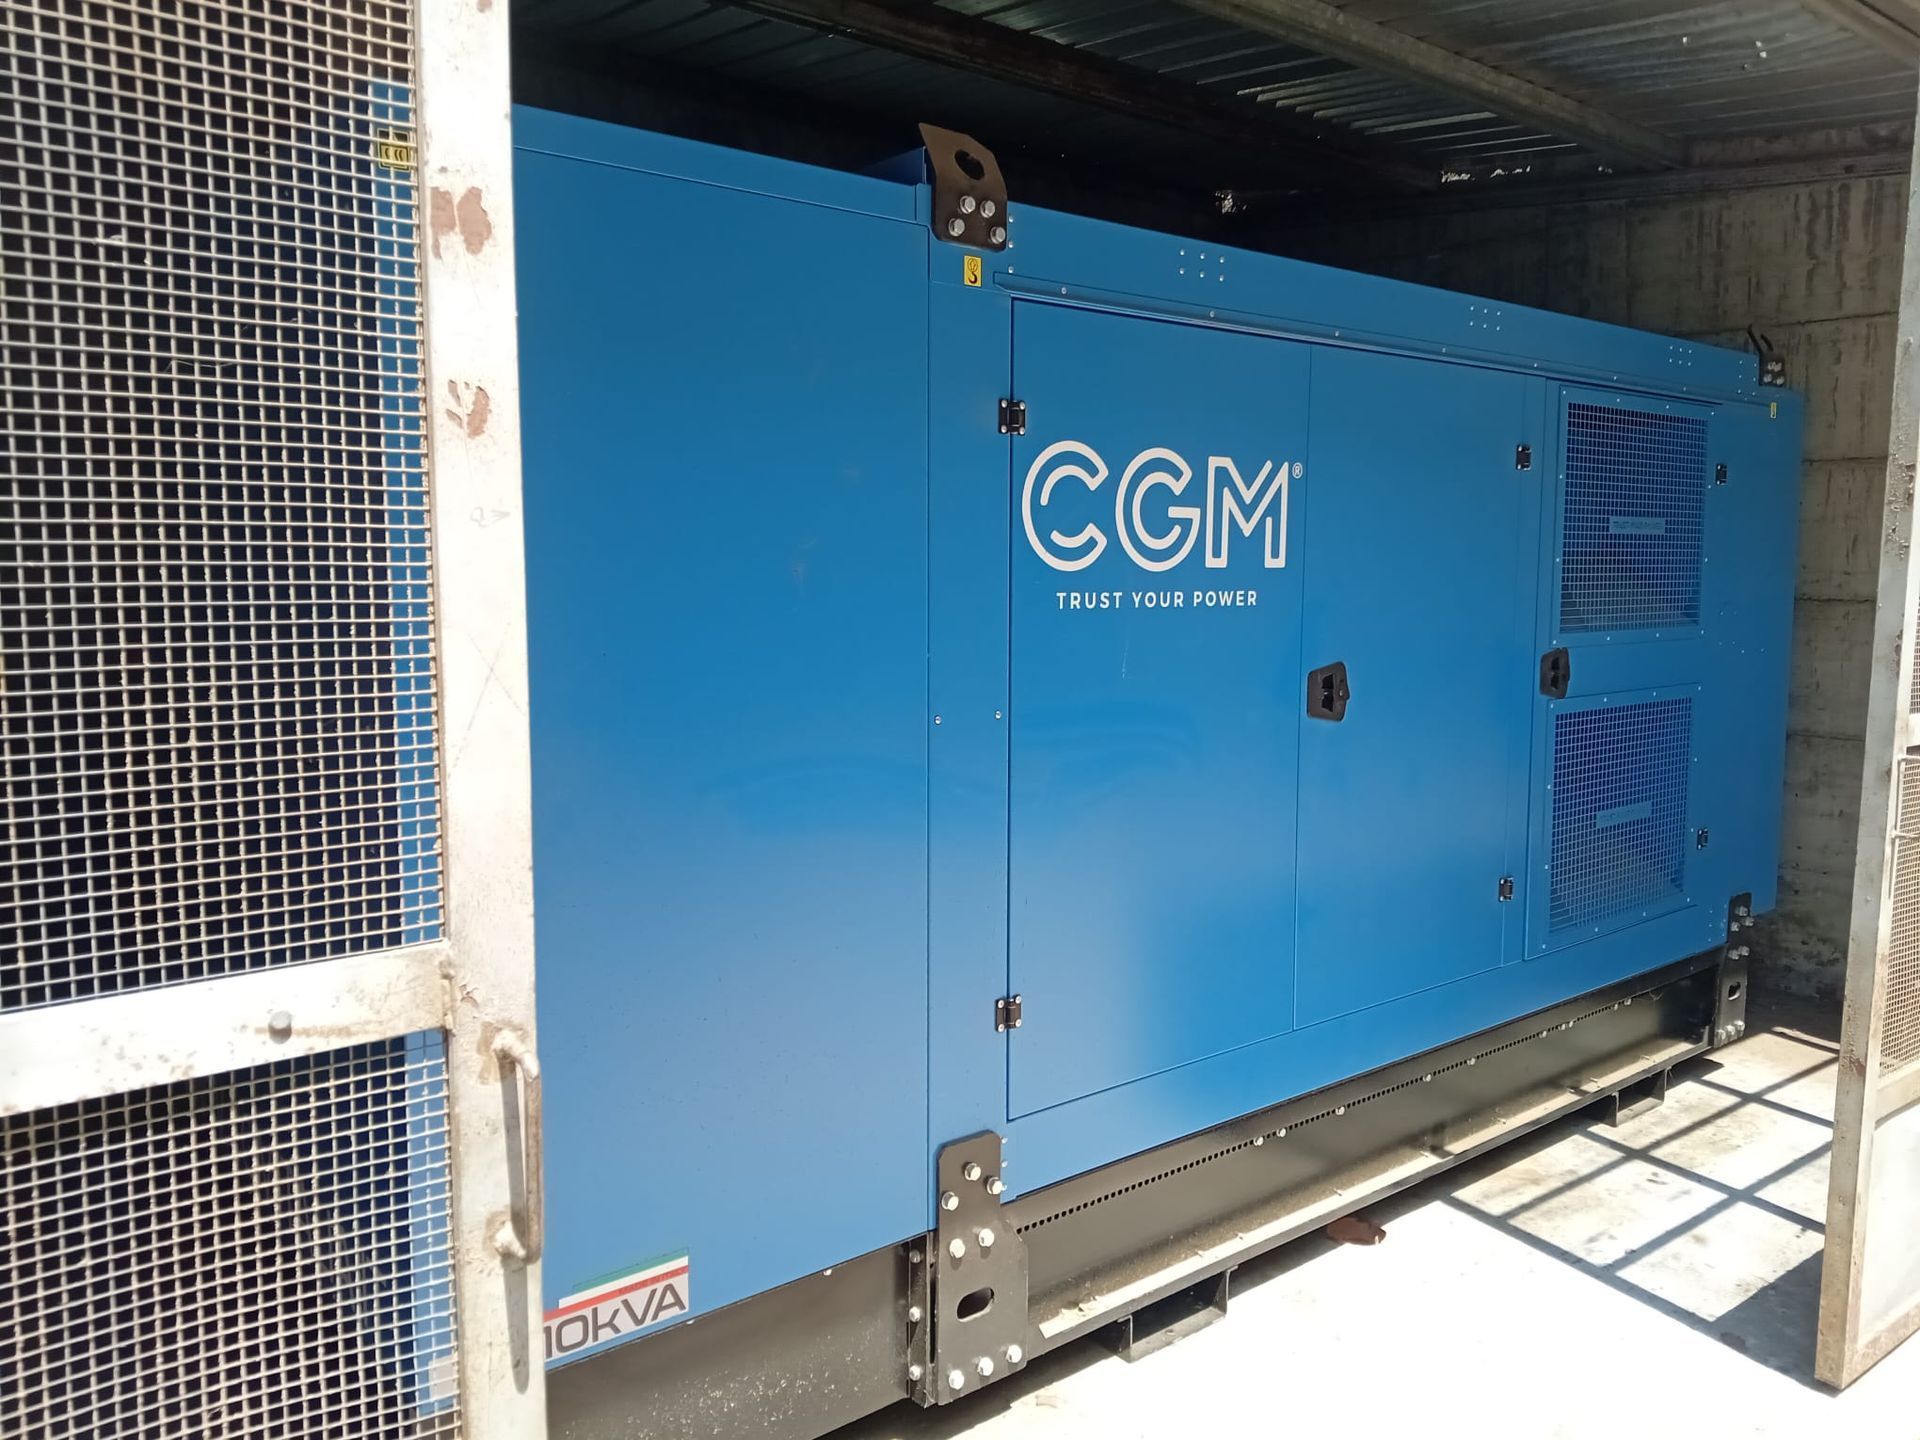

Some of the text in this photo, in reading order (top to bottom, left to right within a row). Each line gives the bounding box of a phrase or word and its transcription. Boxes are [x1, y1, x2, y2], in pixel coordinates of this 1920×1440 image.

[1056, 591, 1257, 610] TRUST YOUR POWER
